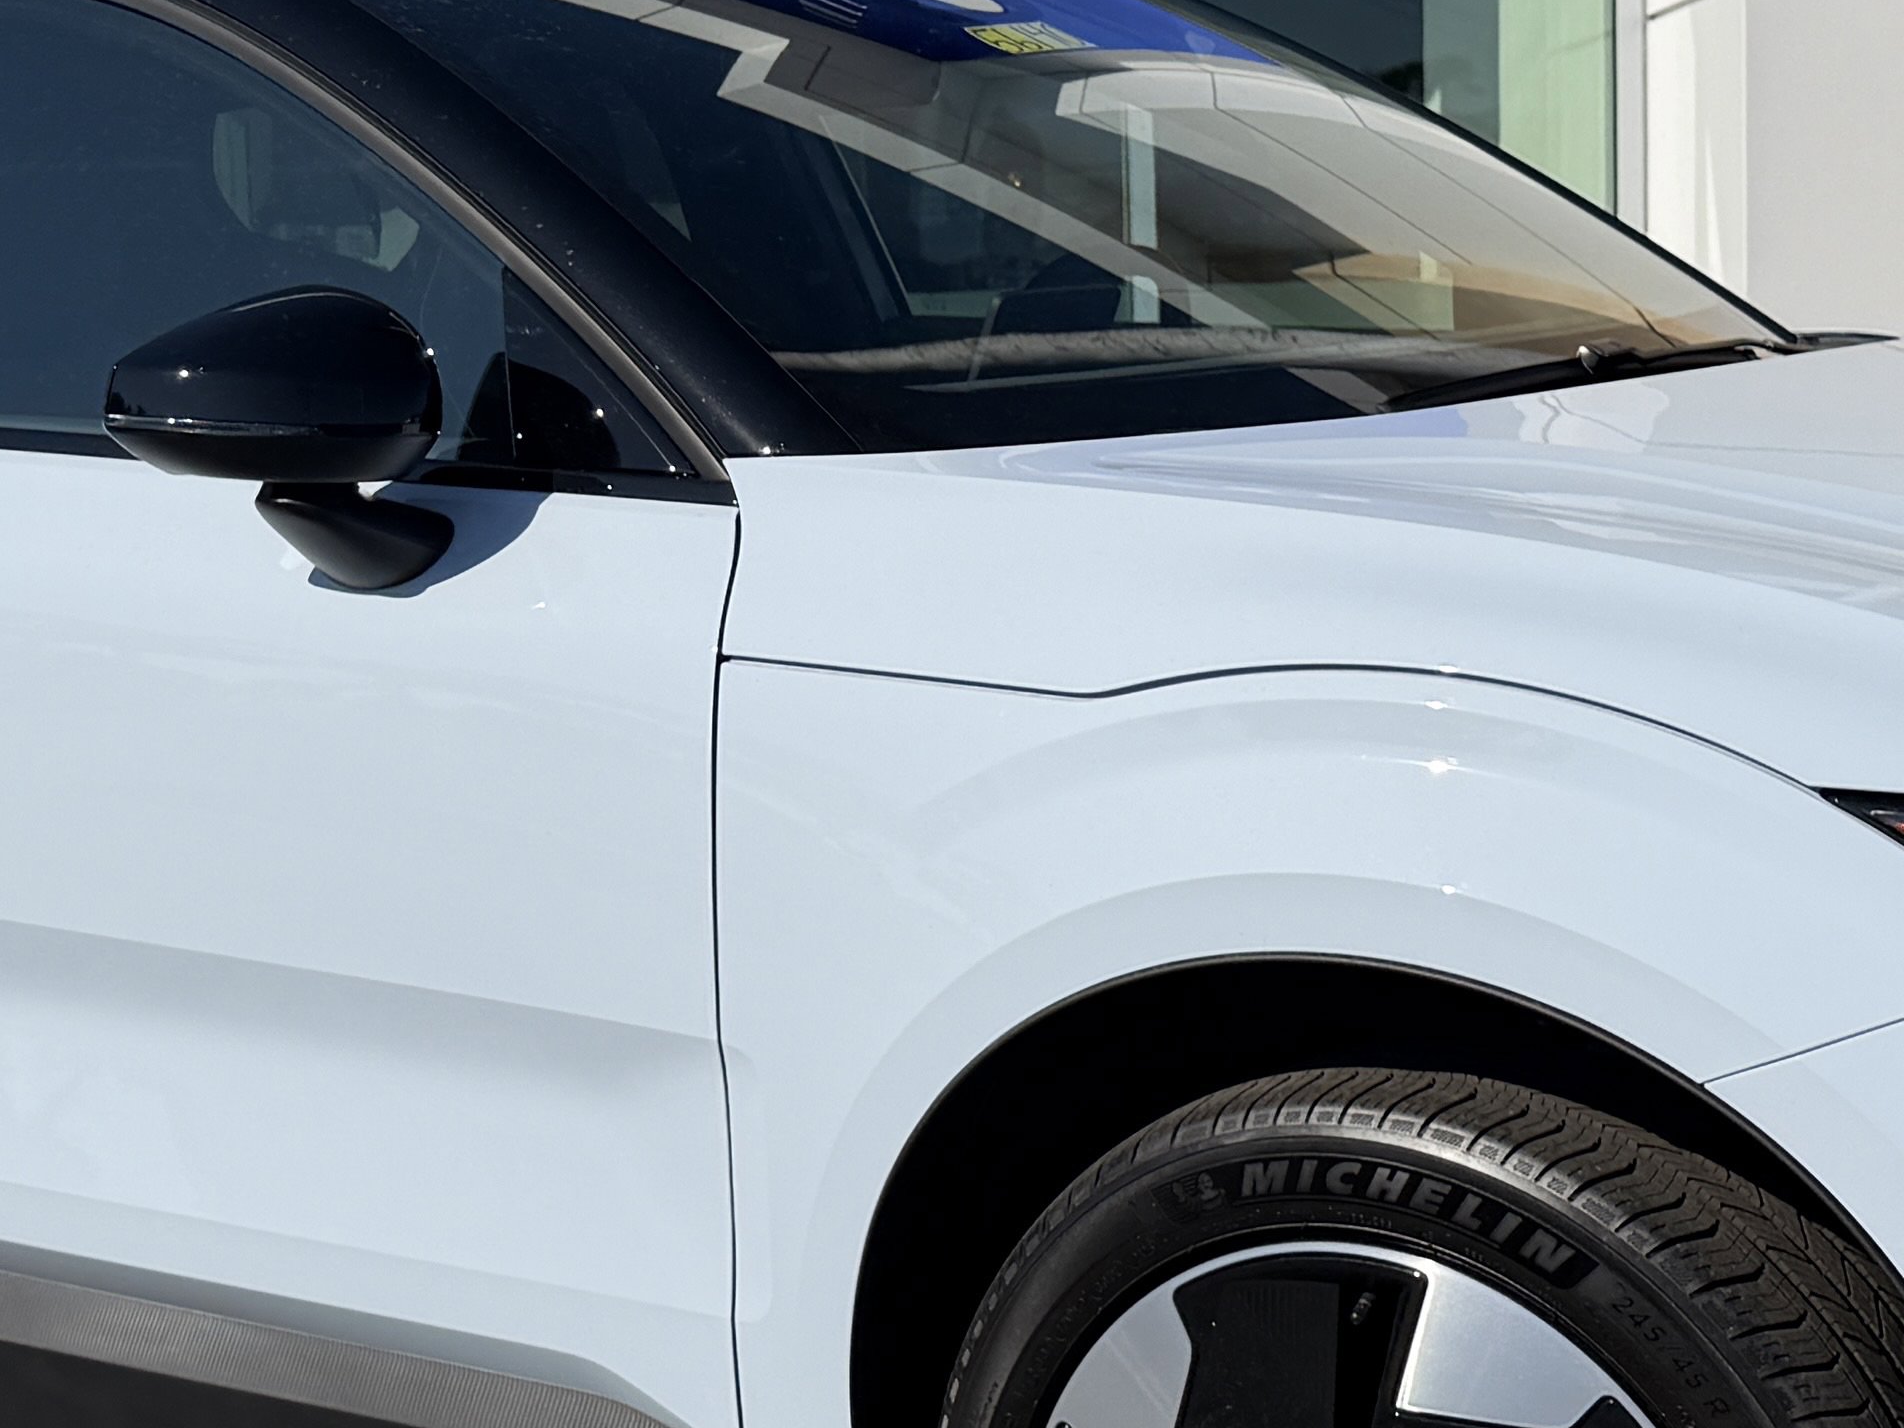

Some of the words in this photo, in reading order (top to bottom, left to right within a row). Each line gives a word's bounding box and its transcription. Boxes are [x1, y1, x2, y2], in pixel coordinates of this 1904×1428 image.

[1241, 1159, 1576, 1273] MICHELIN
[1611, 1295, 1711, 1390] 245/45
[1703, 1396, 1730, 1418] R
